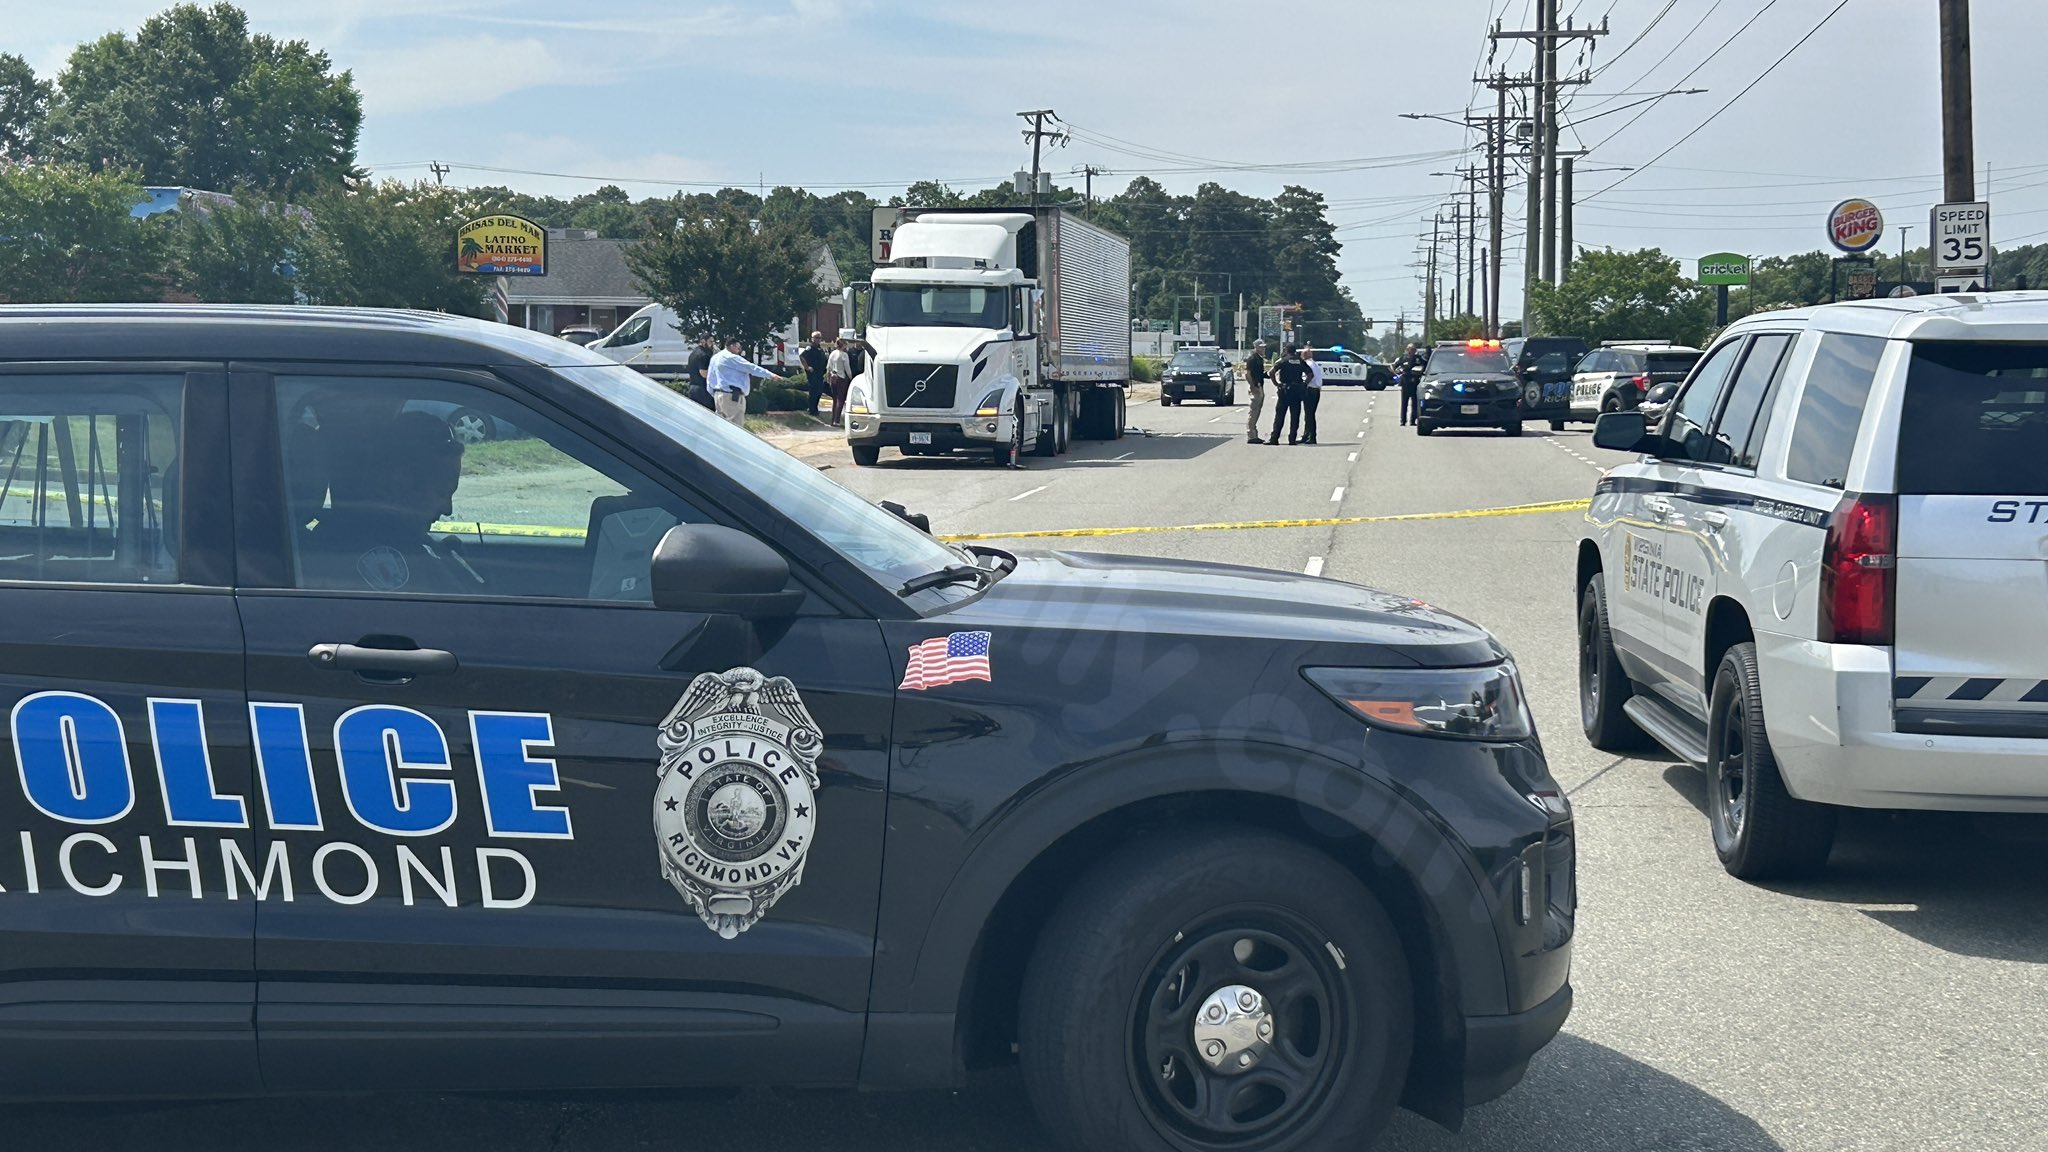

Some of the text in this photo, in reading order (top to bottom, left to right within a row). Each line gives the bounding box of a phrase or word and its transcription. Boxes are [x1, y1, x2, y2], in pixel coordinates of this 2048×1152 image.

[1834, 207, 1876, 228] BURGER
[1939, 210, 1985, 222] SPEED
[497, 218, 518, 229] DEL
[520, 222, 540, 241] MAR
[1836, 216, 1878, 241] KING
[1944, 224, 1980, 235] LIMIT
[485, 235, 526, 245] LATINO
[485, 245, 539, 255] MARKET
[1943, 237, 1983, 262] 35
[1701, 262, 1747, 276] cricket
[1323, 367, 1353, 375] POLICE
[1576, 383, 1602, 396] POLICE
[1803, 509, 1823, 525] UNIT
[1987, 500, 2048, 524] ST
[1631, 554, 1705, 616] STATE POLICE
[712, 713, 769, 727] EXCELLENCE
[697, 721, 742, 736] INTEGRITY
[748, 723, 784, 741] JUSTICE
[10, 690, 574, 840] OLICE
[676, 740, 800, 786] POLICE
[706, 773, 751, 792] STATE
[702, 824, 769, 850] VIRGINIA
[668, 832, 804, 885] RICHMOND, VA.
[0, 831, 537, 909] ICHMOND
